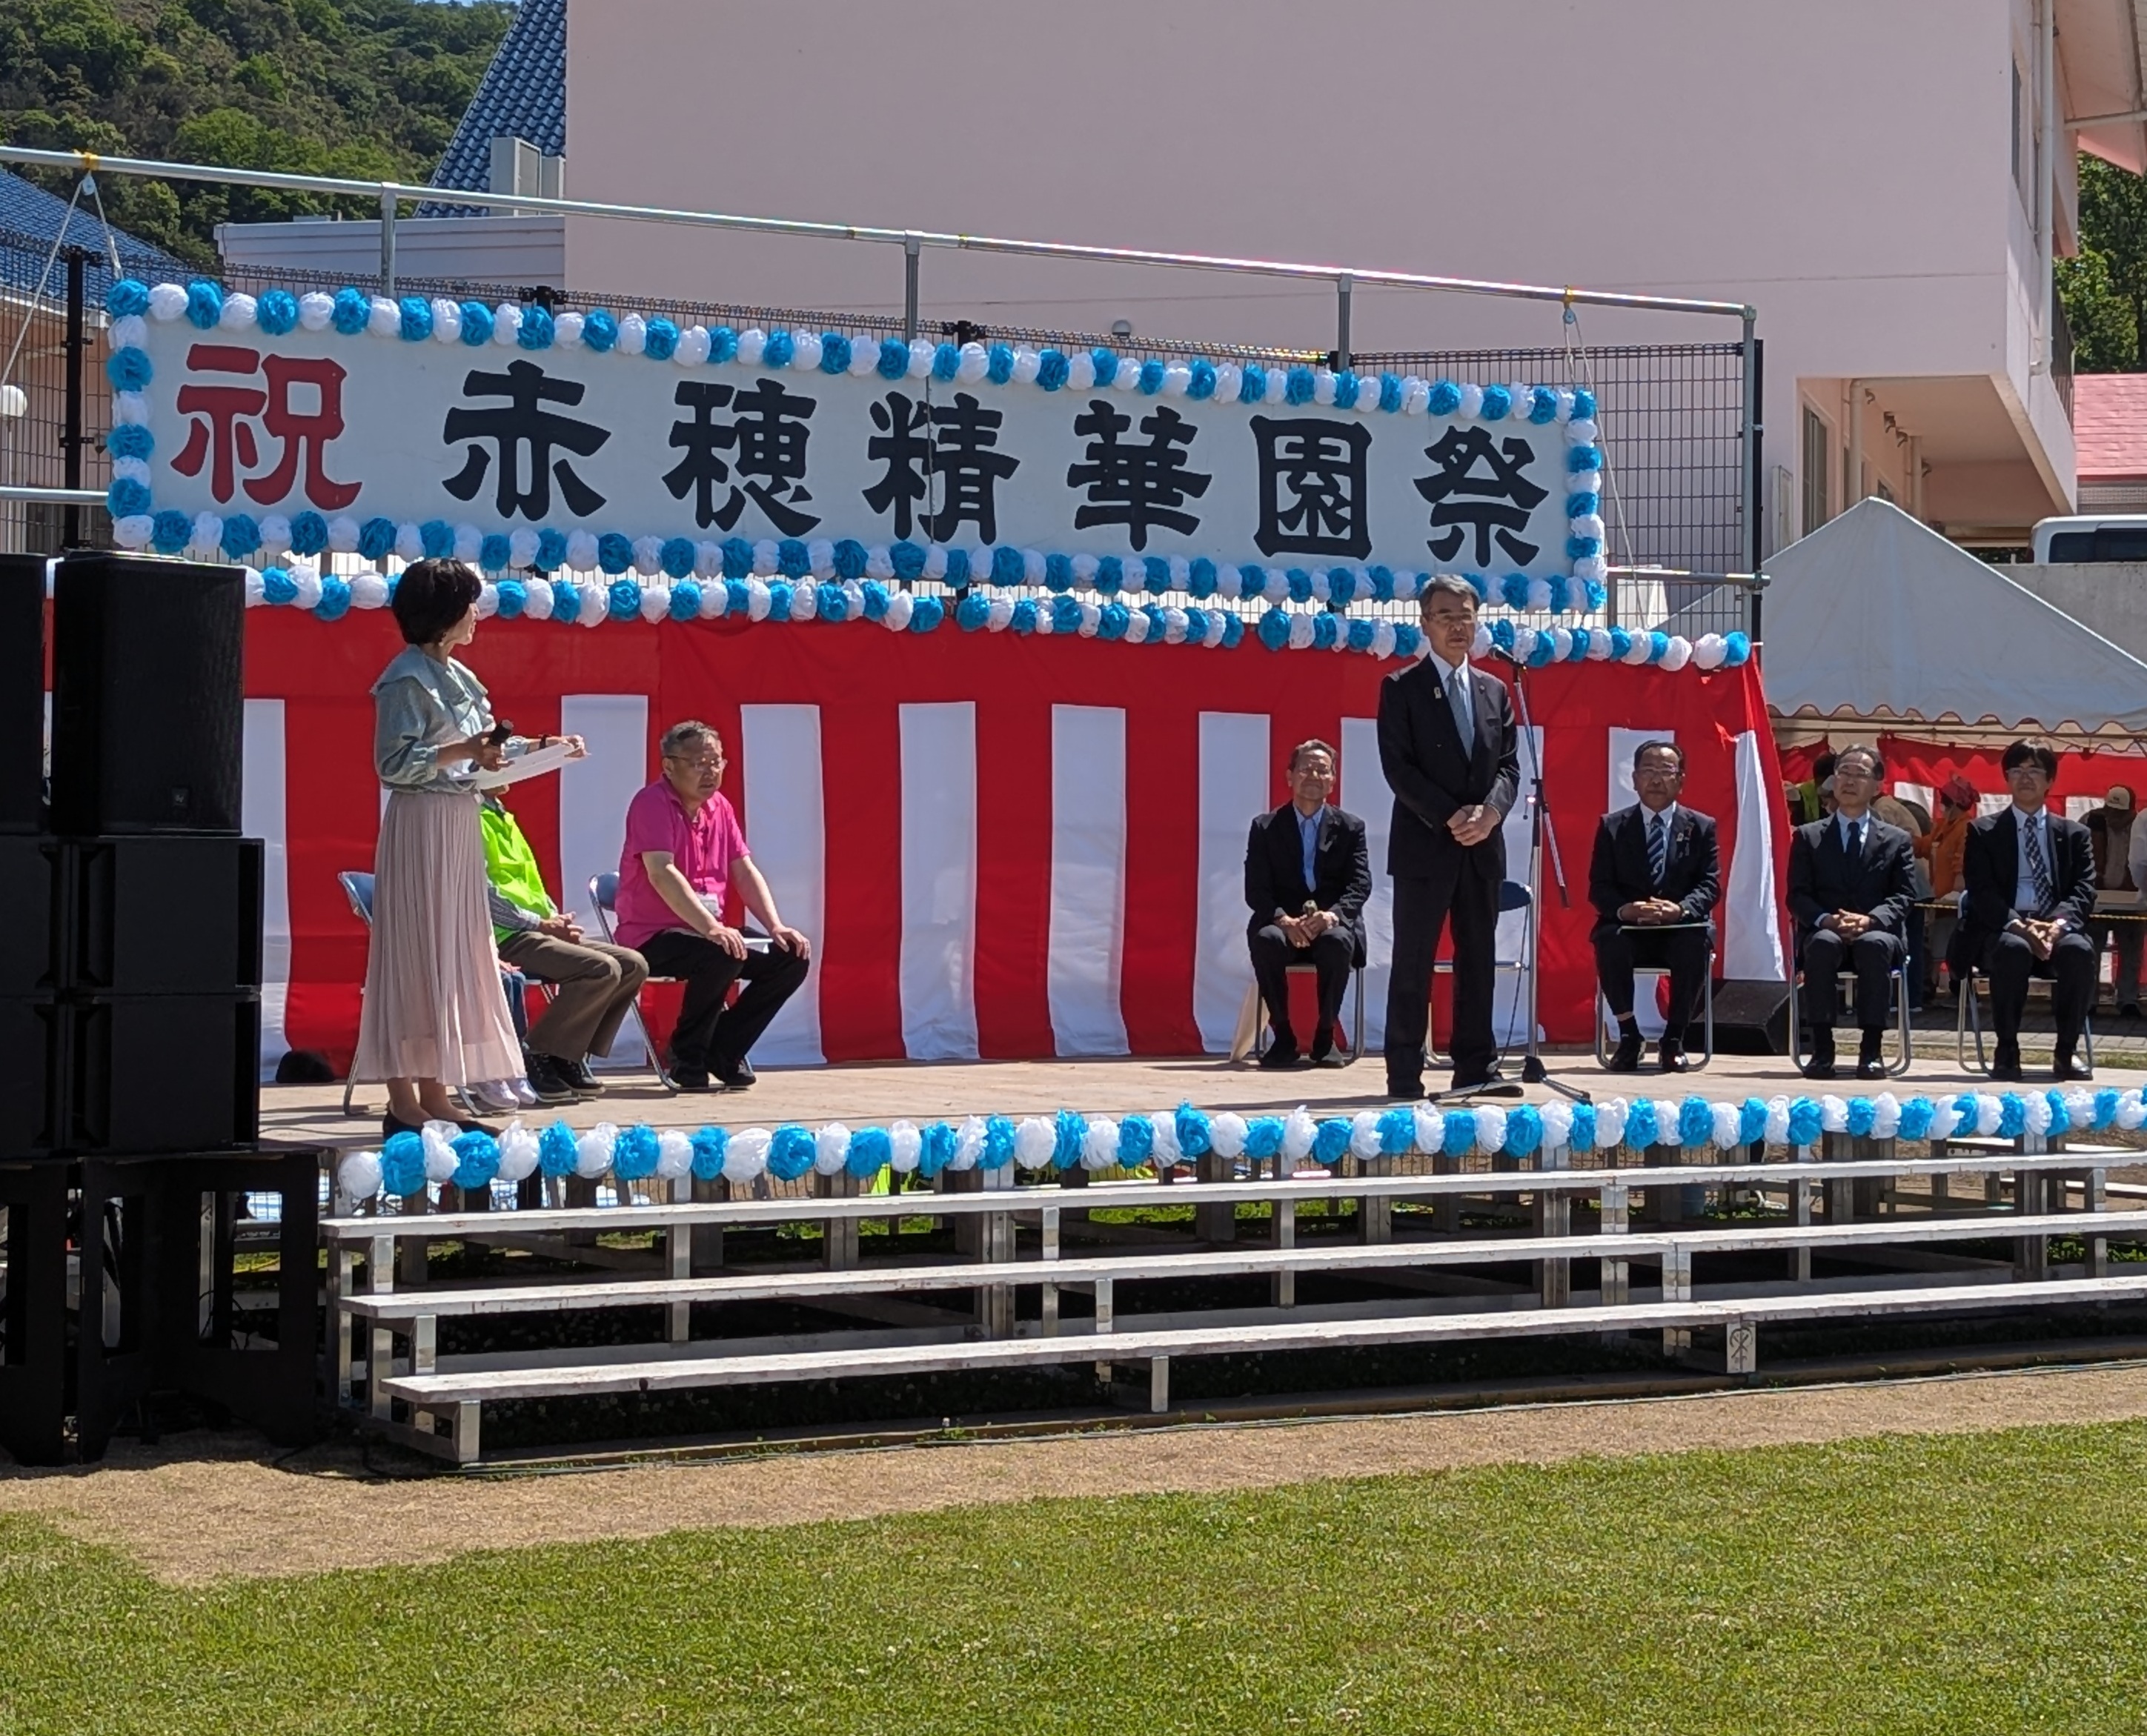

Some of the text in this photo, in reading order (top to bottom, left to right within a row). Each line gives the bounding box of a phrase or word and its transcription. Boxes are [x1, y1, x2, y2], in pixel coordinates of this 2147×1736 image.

[170, 343, 1550, 568] 祝 赤穂精華園祭
